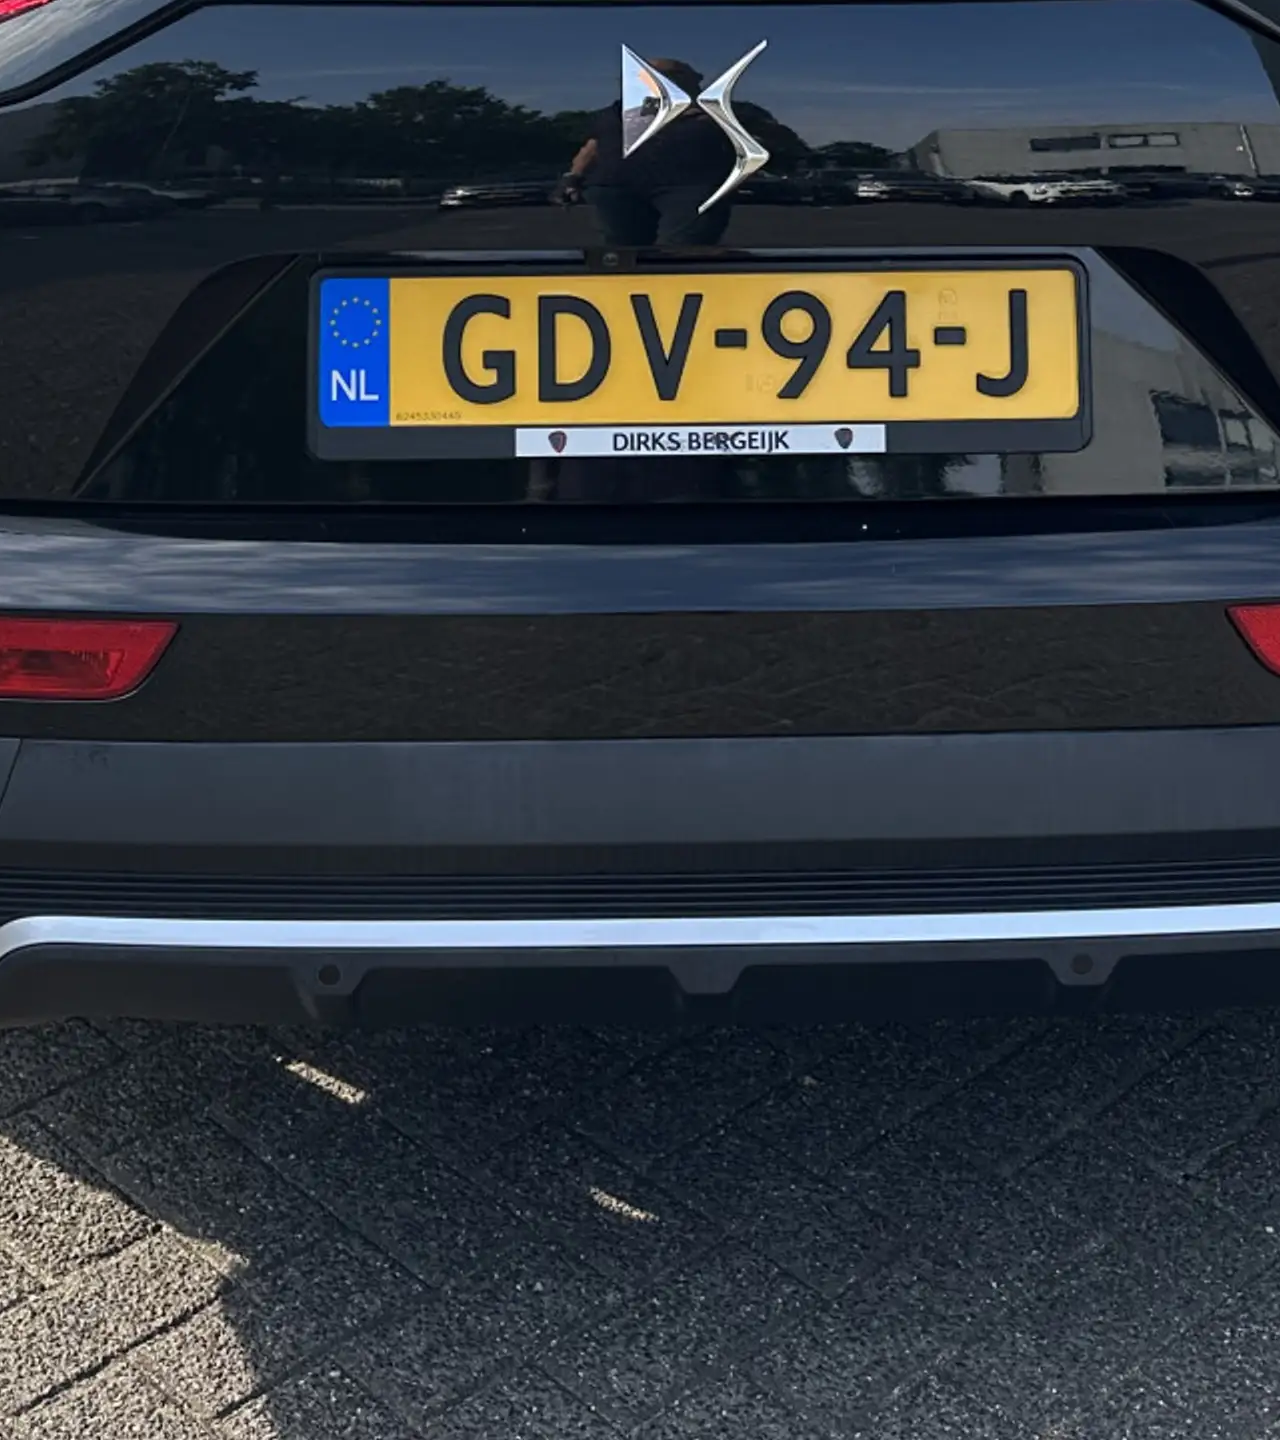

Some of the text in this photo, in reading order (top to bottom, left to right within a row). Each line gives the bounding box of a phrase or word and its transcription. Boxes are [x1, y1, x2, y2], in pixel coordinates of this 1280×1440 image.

[442, 289, 1030, 405] GDV-94-J
[331, 368, 380, 402] NL
[613, 430, 790, 453] DIRKS BERGEIJK
